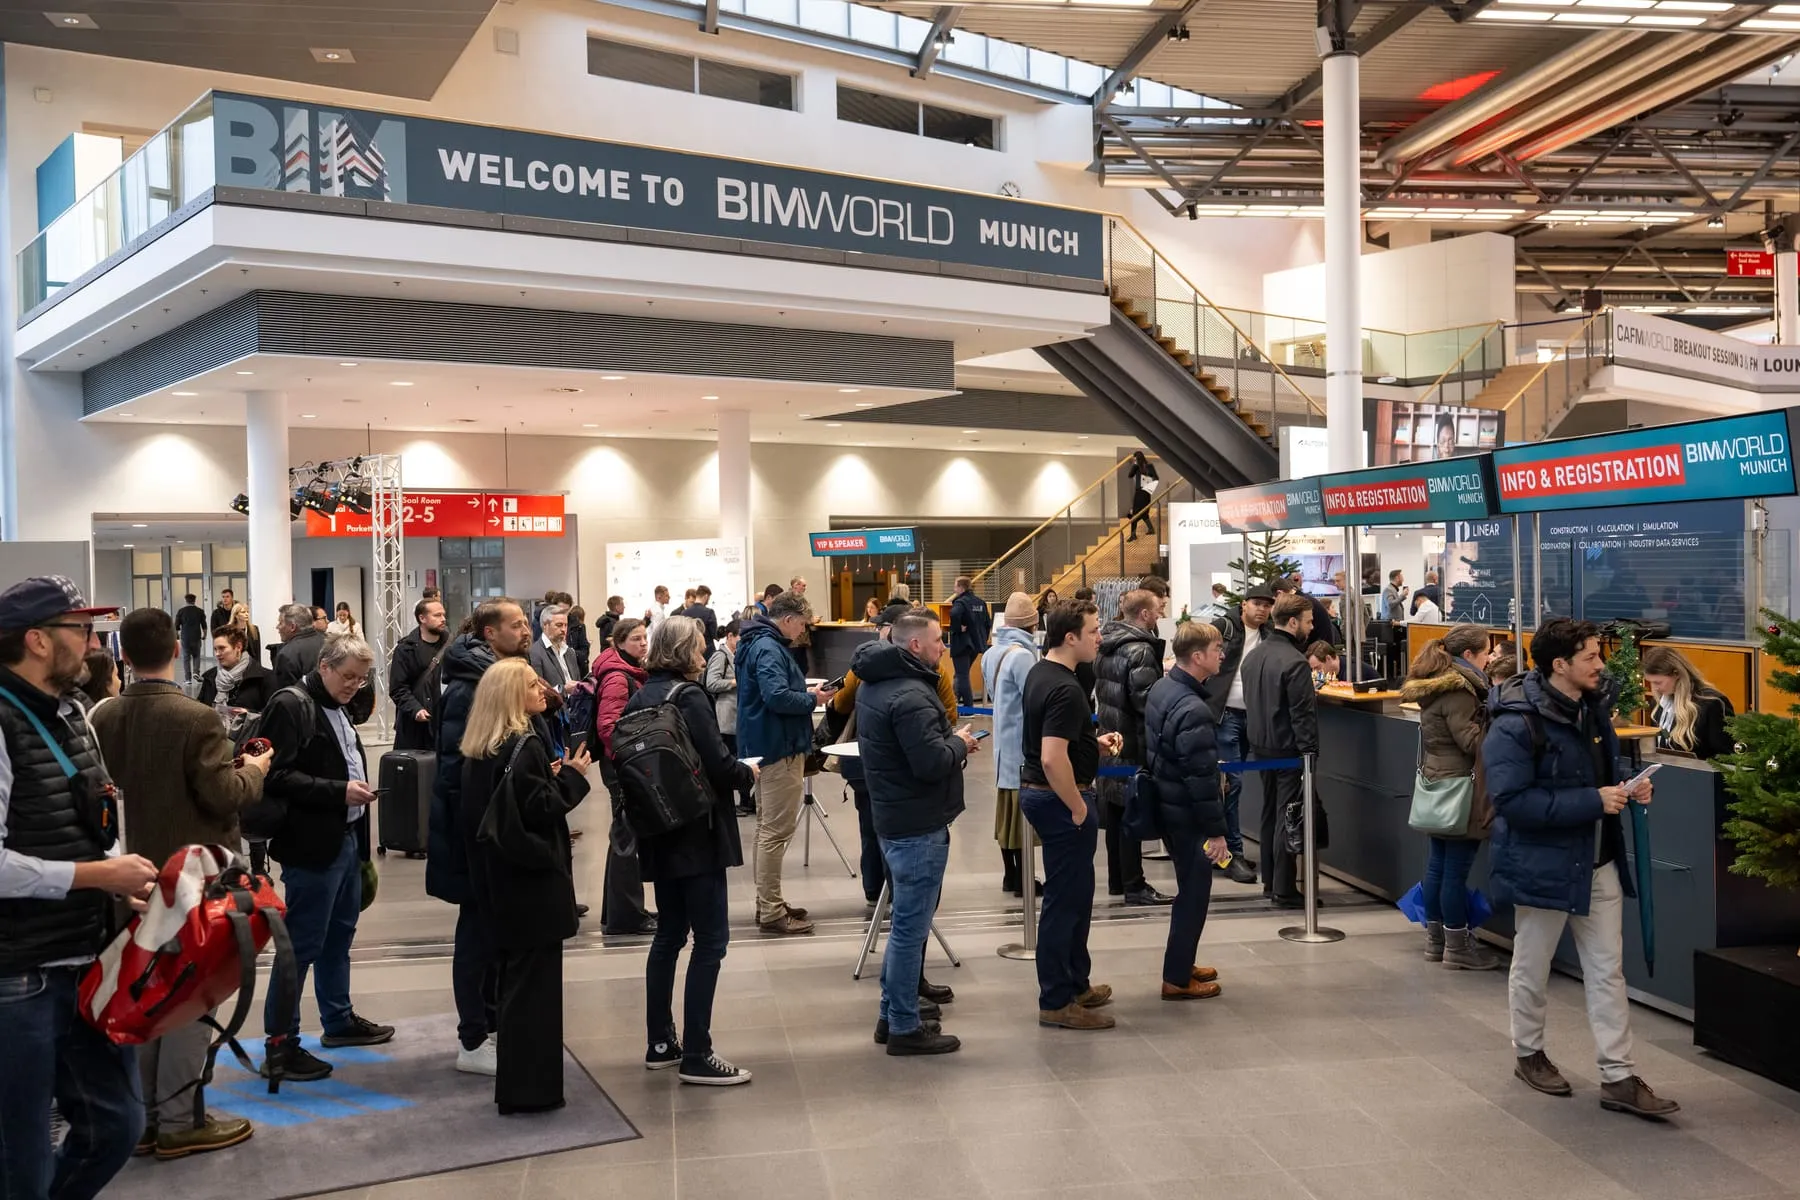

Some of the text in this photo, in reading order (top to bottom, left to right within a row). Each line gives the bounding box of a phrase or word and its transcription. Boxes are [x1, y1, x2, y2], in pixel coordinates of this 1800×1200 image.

[214, 93, 407, 204] BIM
[437, 148, 1080, 256] WELCOME TO BIMWORLD MUNICH
[1738, 264, 1743, 275] 1
[1617, 324, 1673, 352] CAFMWORLD
[1673, 337, 1711, 361] BREAKOUT
[1712, 347, 1739, 366] SESSION
[1739, 356, 1744, 369] 3
[1686, 433, 1784, 463] BIMWORLD
[1502, 453, 1681, 492] INFO & REGISTRATION
[1740, 458, 1787, 476] MUNICH
[1427, 474, 1481, 493] BIMWORLD
[402, 496, 442, 505] Saal Room
[1286, 490, 1320, 506] BIMWORLD
[1325, 485, 1427, 509] INFO & REGISTRATION
[1458, 492, 1484, 505] MUNICH
[328, 514, 337, 532] 1
[403, 506, 435, 523] 2-5
[1472, 523, 1500, 536] LINEAR
[1550, 521, 1679, 535] CONSTRUCTION CALCULATION SIMULATION
[817, 539, 864, 549] VIP & SPEAKER
[879, 534, 911, 543] BIMWORLD
[1579, 540, 1622, 549] COLLABORATION
[1628, 539, 1655, 548] INDUSTRY
[1656, 539, 1671, 547] DATA
[1671, 537, 1699, 547] SERVICES
